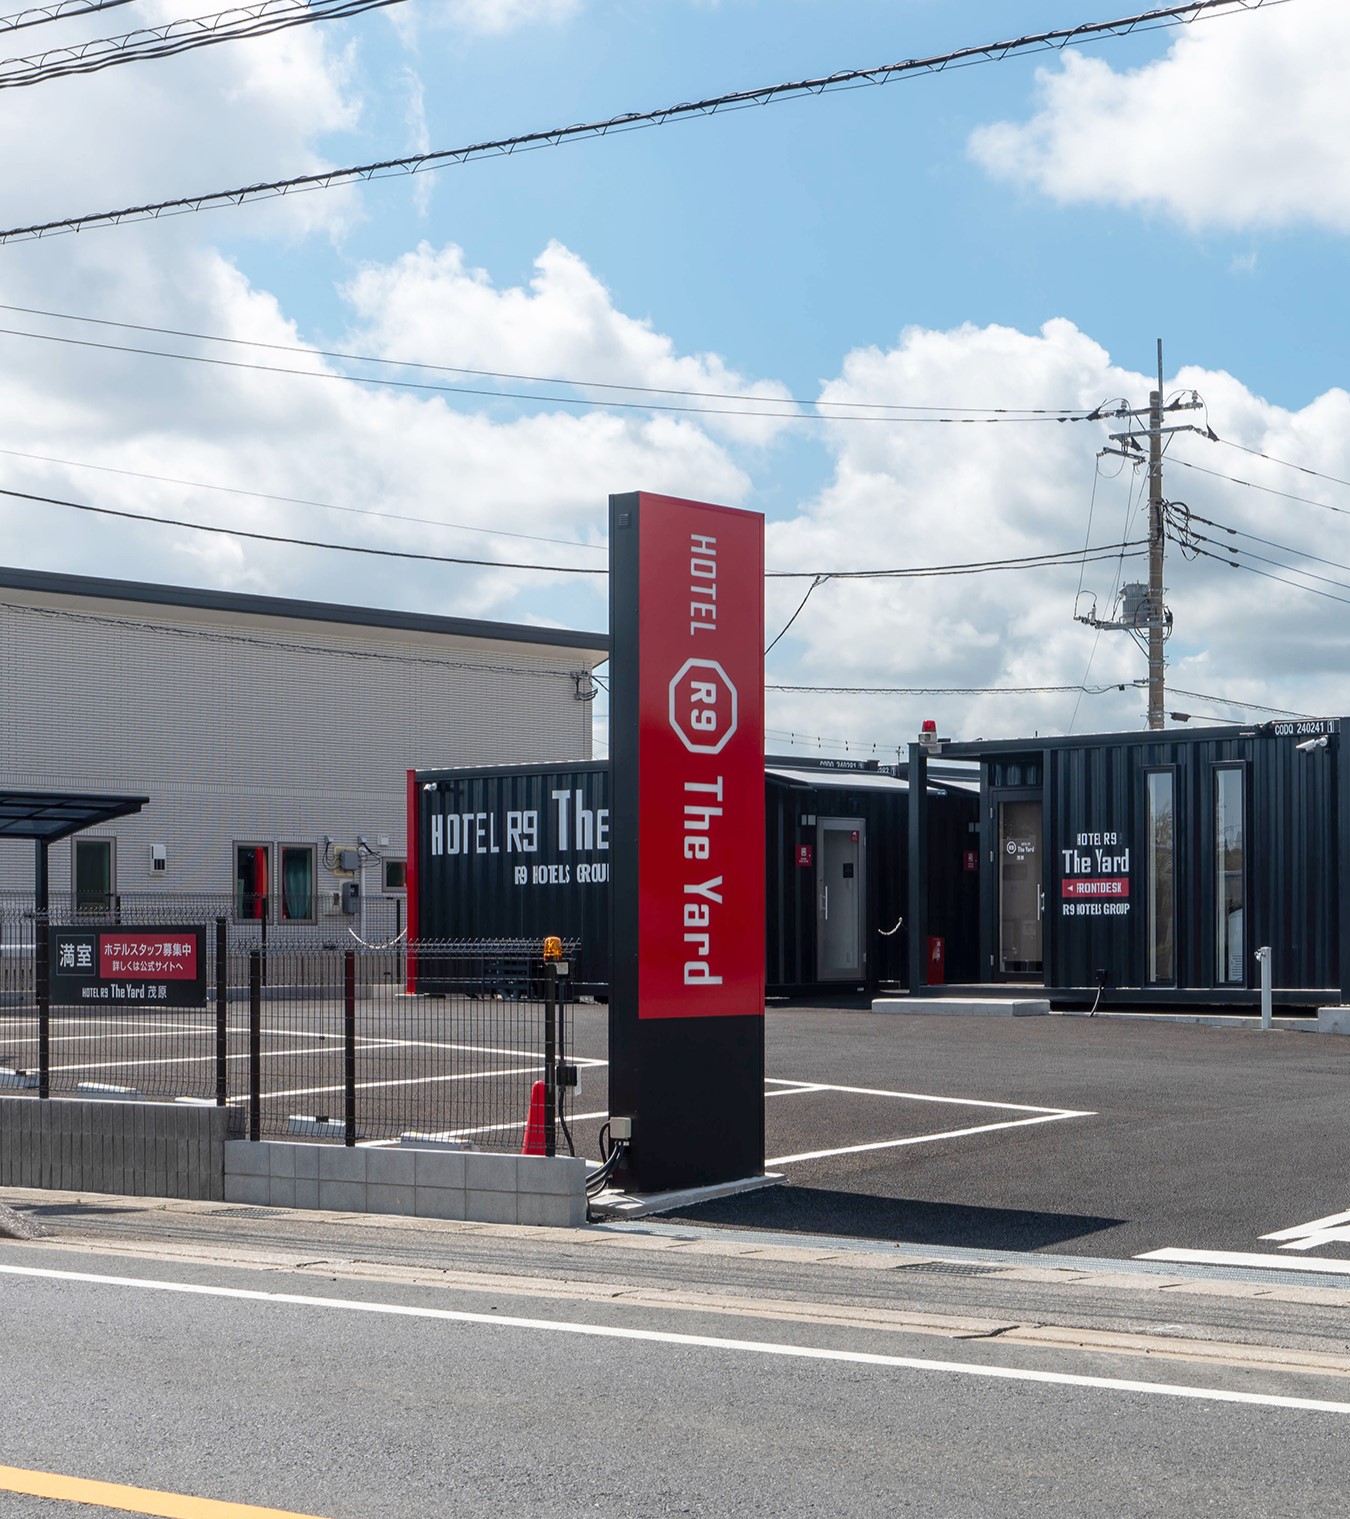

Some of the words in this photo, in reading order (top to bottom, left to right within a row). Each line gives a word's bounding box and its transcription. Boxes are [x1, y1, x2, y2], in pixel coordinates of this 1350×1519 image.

[691, 534, 716, 635] HOTEL
[691, 681, 716, 731] R9
[1297, 721, 1324, 734] 240241
[432, 812, 499, 855] HOTEL
[507, 810, 538, 852] R9
[552, 789, 609, 851] The
[684, 776, 723, 859] The
[1077, 833, 1101, 846] HOTEL
[1104, 832, 1117, 845] R9
[1062, 849, 1091, 873] The
[1095, 848, 1129, 873] Yard
[515, 866, 527, 885] R9
[533, 865, 570, 884] HOTELS
[577, 863, 609, 883] GROU
[1063, 904, 1075, 916] R9
[1103, 902, 1130, 915] GROUP
[684, 875, 723, 985] Yard
[60, 943, 92, 967] 満室
[104, 943, 192, 957] ホテルスタッフ募集中
[112, 960, 183, 972] 詳しくは公式サイトへ
[82, 987, 99, 998] HOTEL
[101, 987, 109, 998] R9
[111, 984, 125, 998] The
[126, 984, 145, 998] Yard
[147, 985, 167, 999] 茂原
